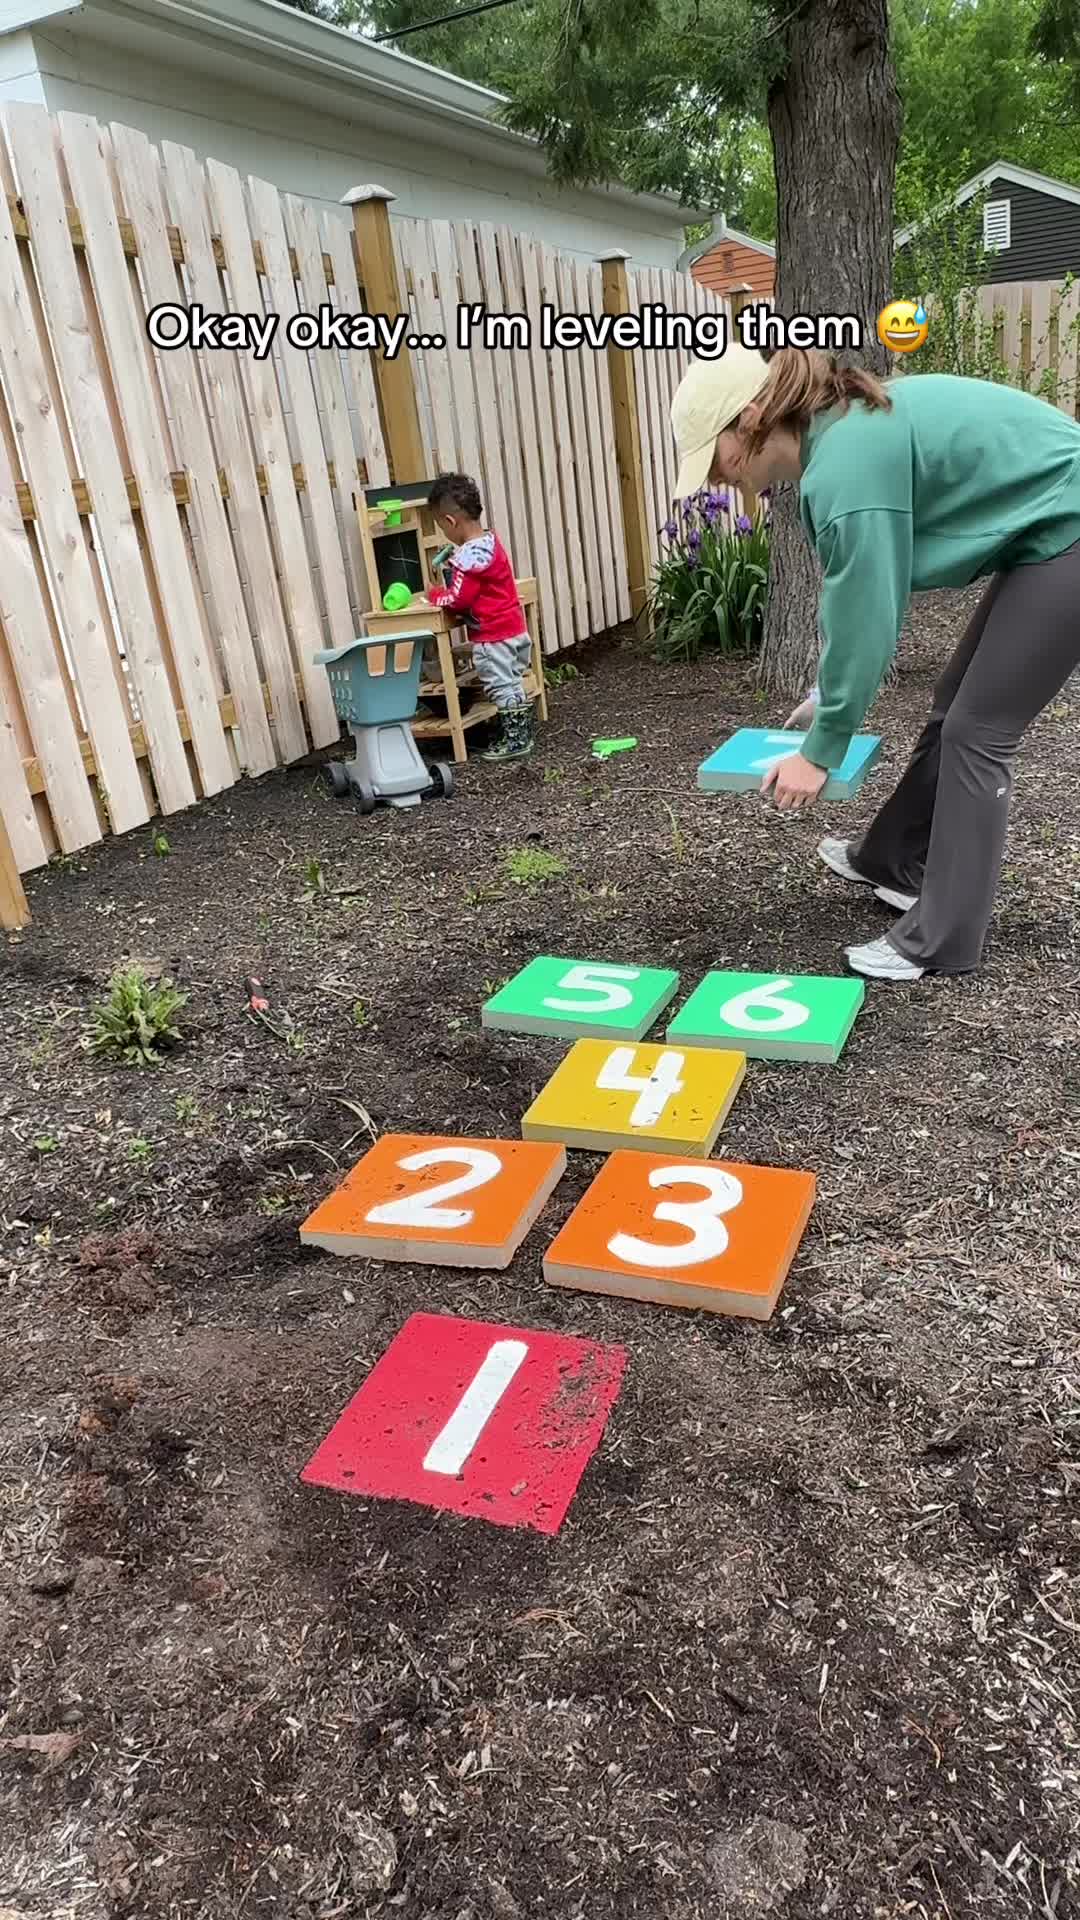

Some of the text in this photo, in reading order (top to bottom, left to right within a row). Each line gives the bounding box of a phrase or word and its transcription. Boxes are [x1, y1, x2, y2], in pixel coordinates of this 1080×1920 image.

[542, 964, 641, 1013] 5
[719, 978, 811, 1032] 6
[595, 1046, 686, 1128] 4
[365, 1146, 503, 1229] 2
[607, 1165, 744, 1268] 3
[421, 1338, 529, 1475] 1
